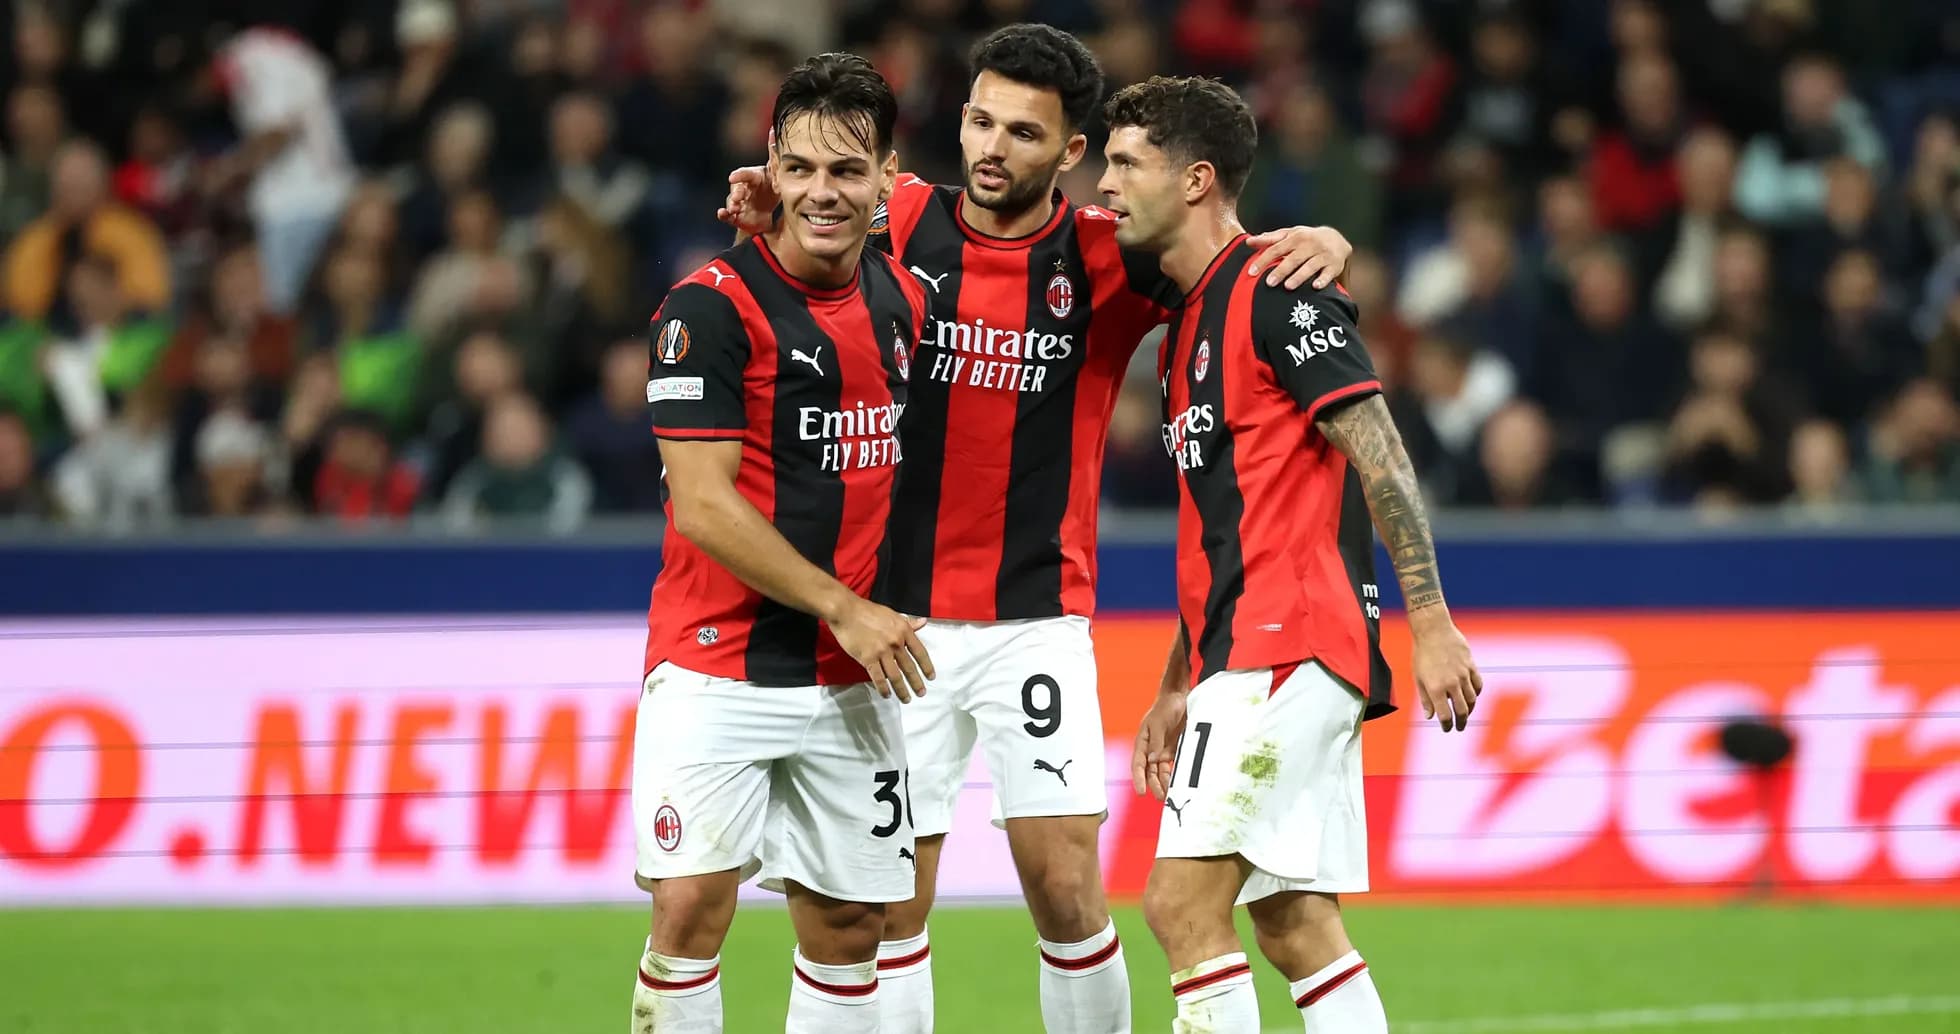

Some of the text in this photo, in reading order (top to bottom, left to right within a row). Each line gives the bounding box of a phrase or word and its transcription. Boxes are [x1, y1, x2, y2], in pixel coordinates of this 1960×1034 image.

[1285, 325, 1347, 367] MSC
[930, 353, 1047, 392] FLY BETTER
[821, 443, 852, 471] FLY
[1021, 673, 1062, 738] 9
[871, 764, 914, 838] 3
